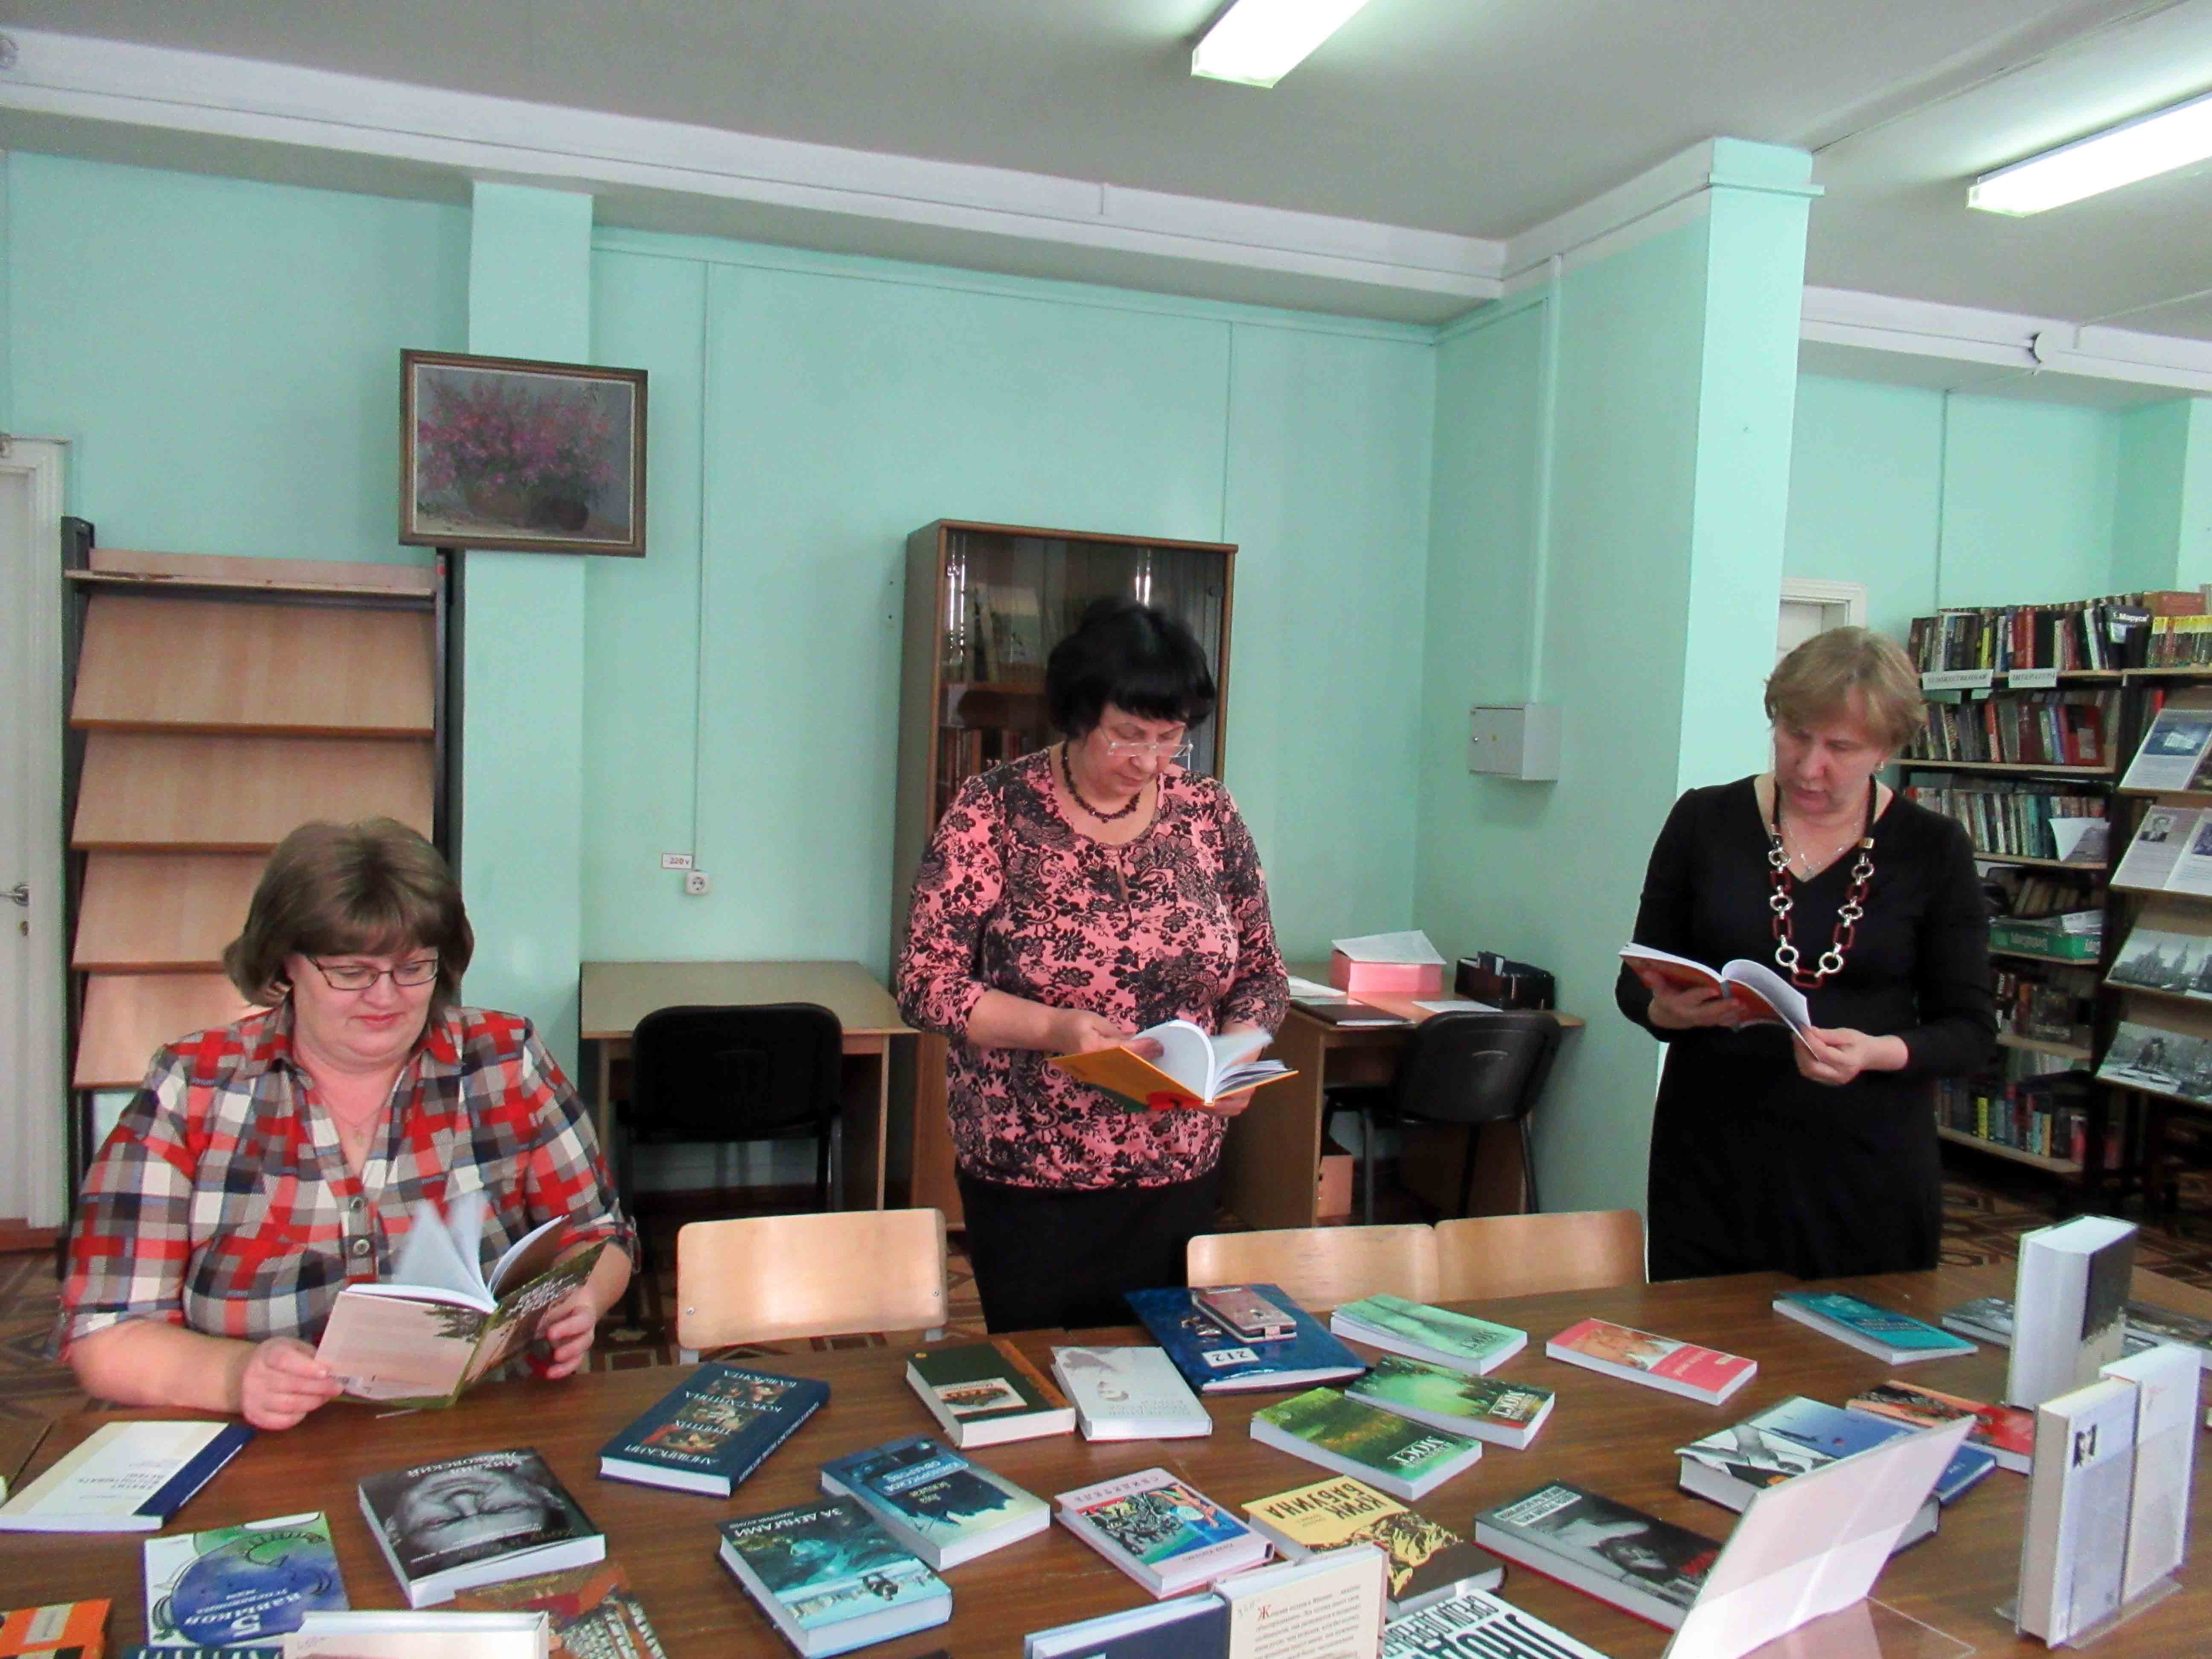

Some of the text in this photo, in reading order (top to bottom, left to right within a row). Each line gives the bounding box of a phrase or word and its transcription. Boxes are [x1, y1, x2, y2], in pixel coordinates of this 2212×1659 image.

[1212, 1351, 1249, 1362] 212
[1262, 1482, 1363, 1520] БАБУИНА
[1337, 1490, 1388, 1520] КРИК
[820, 1508, 842, 1517] ЗА
[232, 1615, 261, 1636] 5
